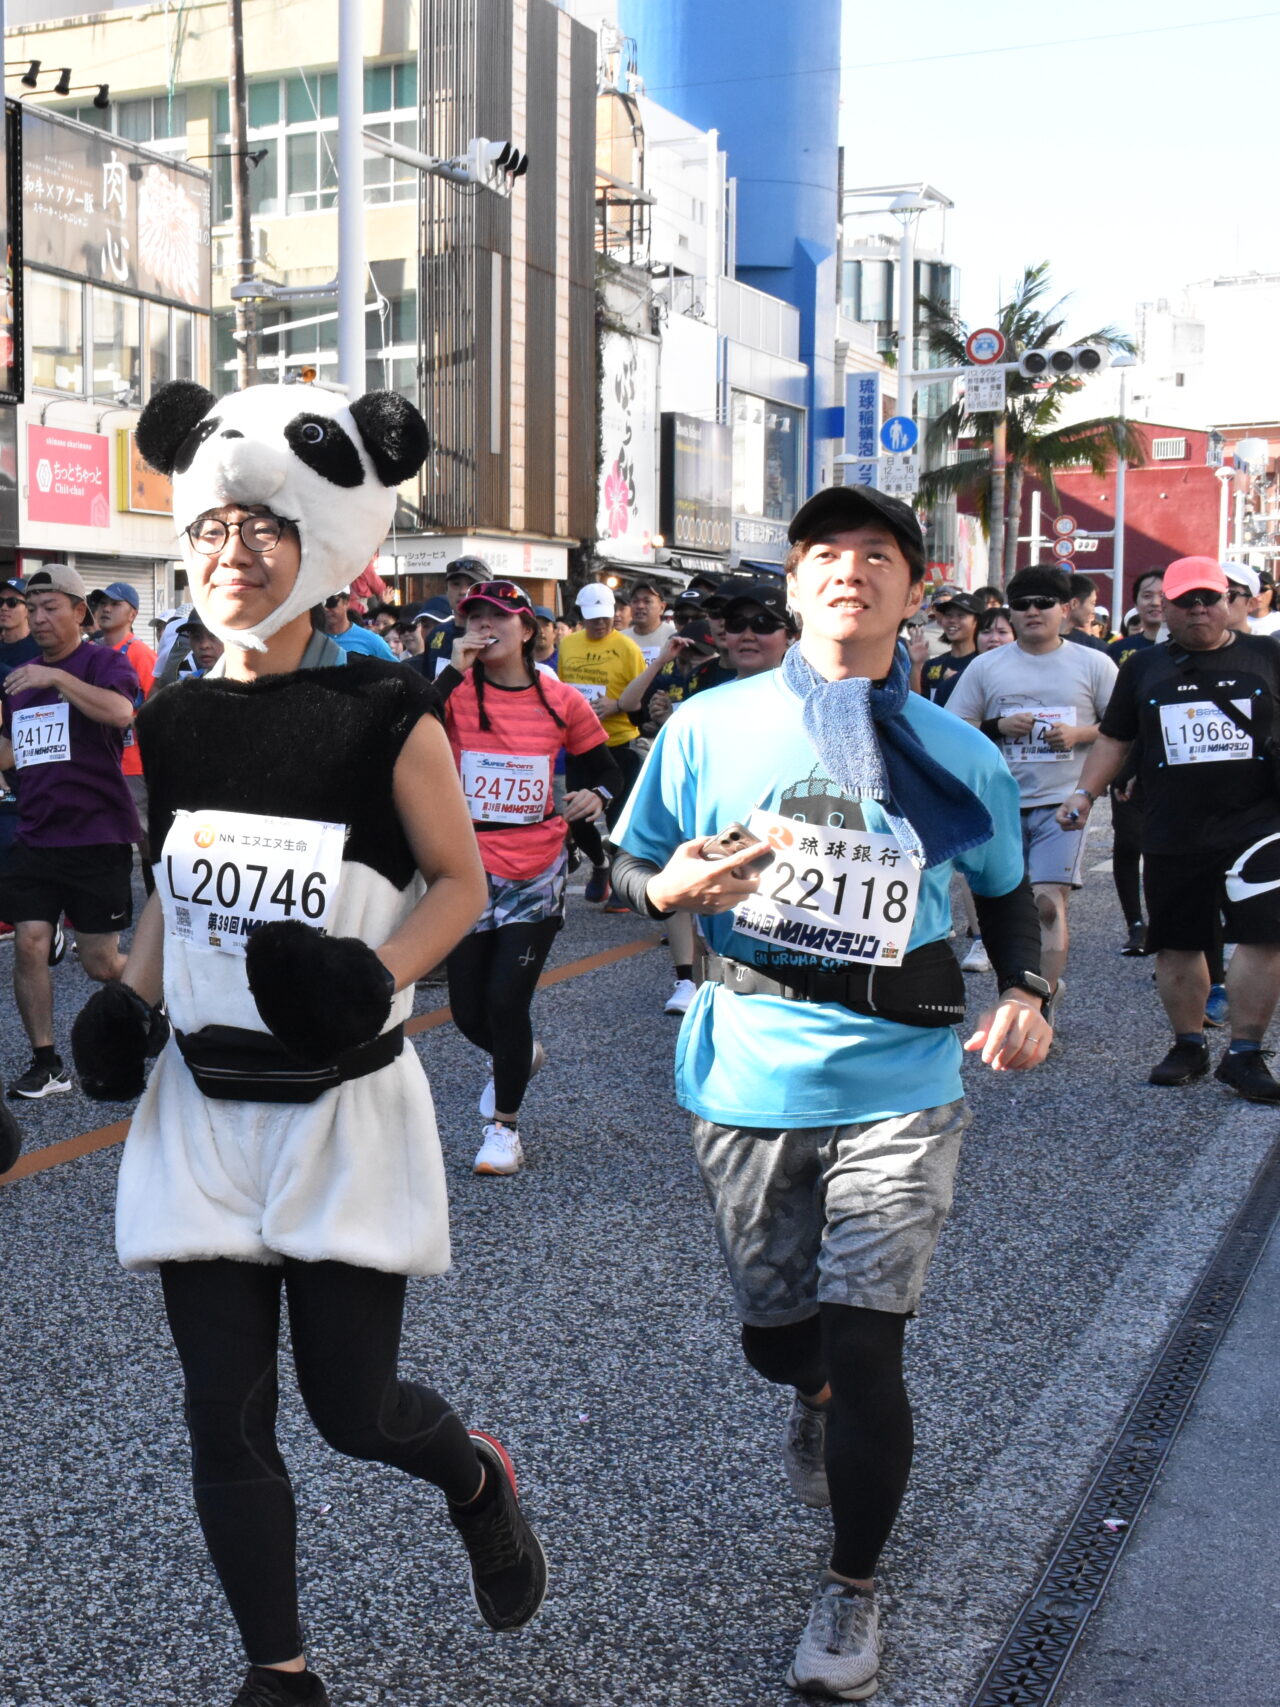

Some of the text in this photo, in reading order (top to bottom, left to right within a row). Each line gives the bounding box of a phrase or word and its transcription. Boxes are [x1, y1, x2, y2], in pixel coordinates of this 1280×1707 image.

[53, 461, 103, 485] ちっとちゃっと
[1177, 680, 1237, 692] OAEY
[463, 773, 544, 802] L24753
[219, 833, 235, 844] NN
[241, 835, 308, 853] エヌエヌ生命
[798, 836, 902, 868] 琉球銀行
[167, 854, 327, 920] L20746
[755, 861, 909, 924] 22118
